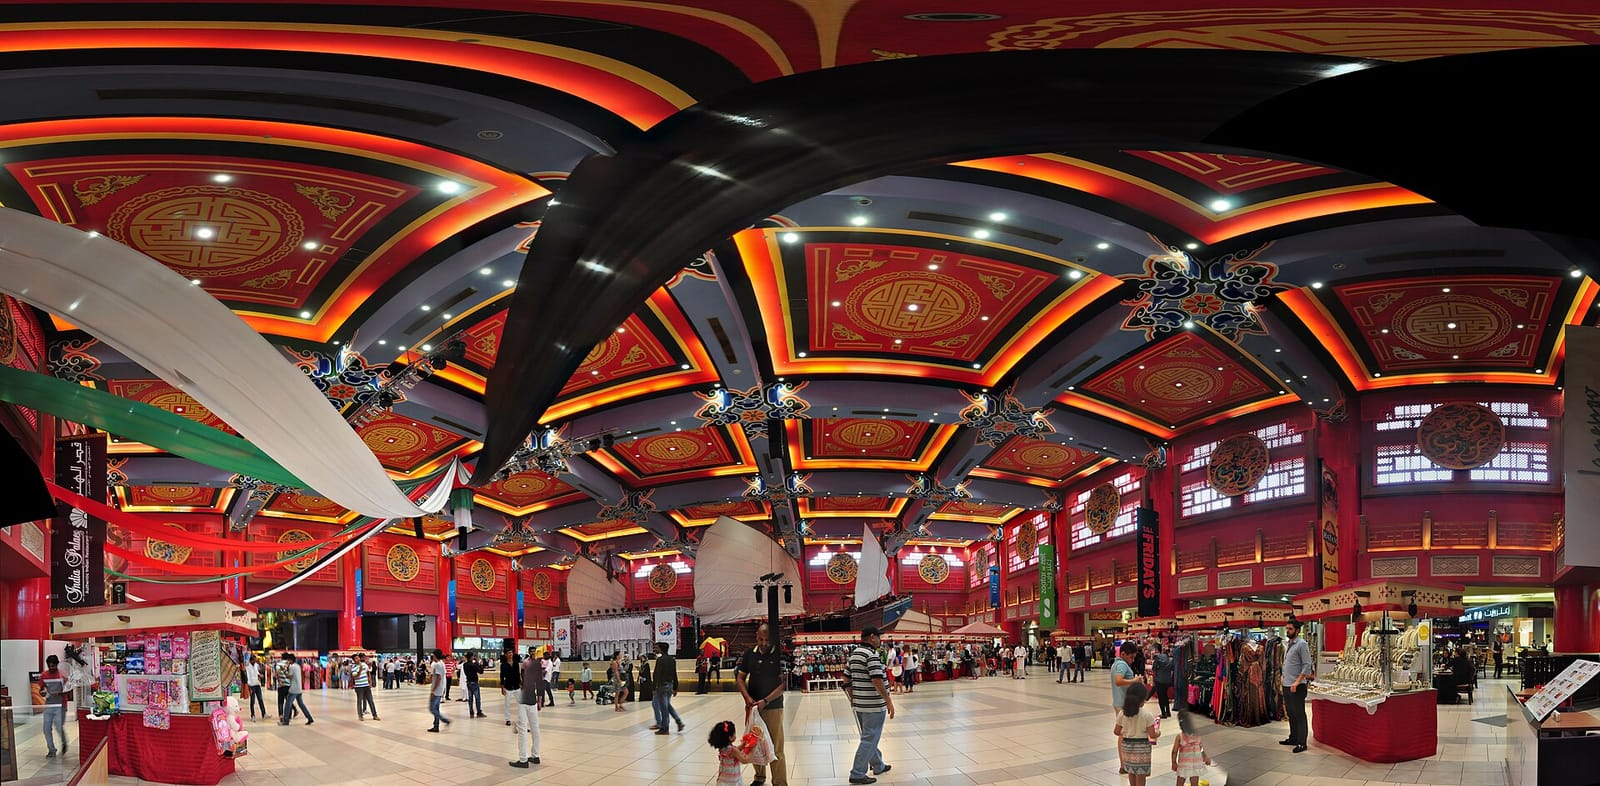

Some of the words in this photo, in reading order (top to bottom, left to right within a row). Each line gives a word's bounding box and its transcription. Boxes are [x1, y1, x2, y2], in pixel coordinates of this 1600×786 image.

[71, 442, 86, 466] قصر
[65, 530, 84, 567] Palace
[65, 569, 83, 604] India
